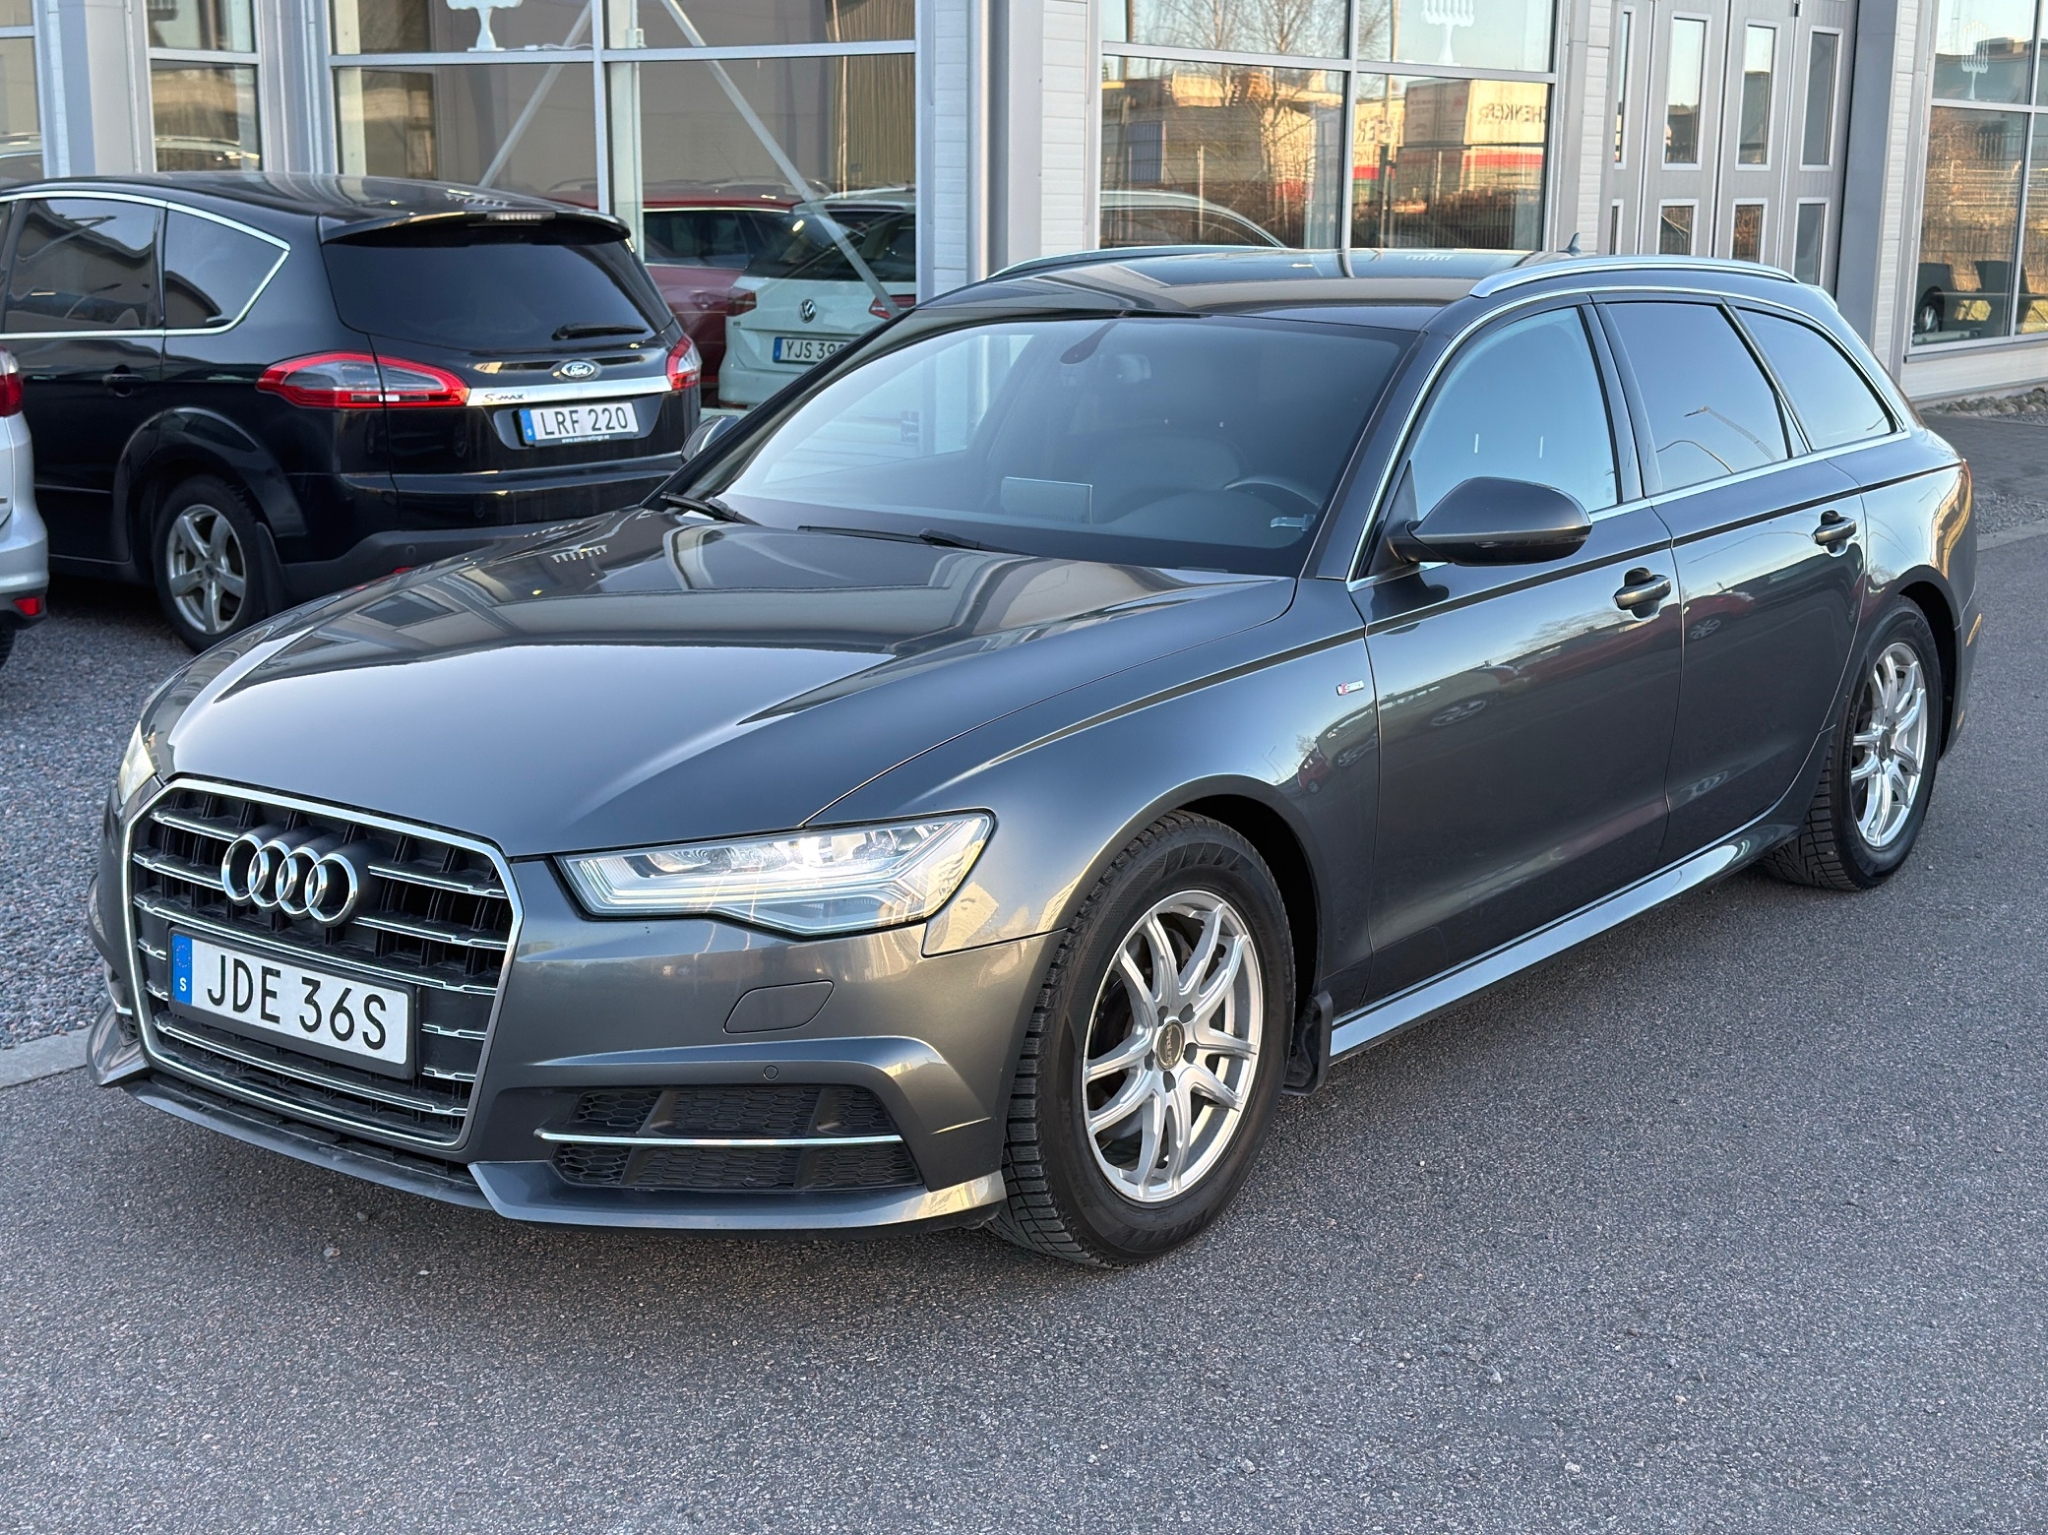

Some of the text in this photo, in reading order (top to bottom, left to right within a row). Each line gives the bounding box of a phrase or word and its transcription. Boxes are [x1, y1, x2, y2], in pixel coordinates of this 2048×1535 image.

[785, 341, 846, 360] YJS 39
[539, 406, 629, 437] LRF 220
[179, 977, 187, 992] S
[207, 954, 387, 1050] JDE 36S
